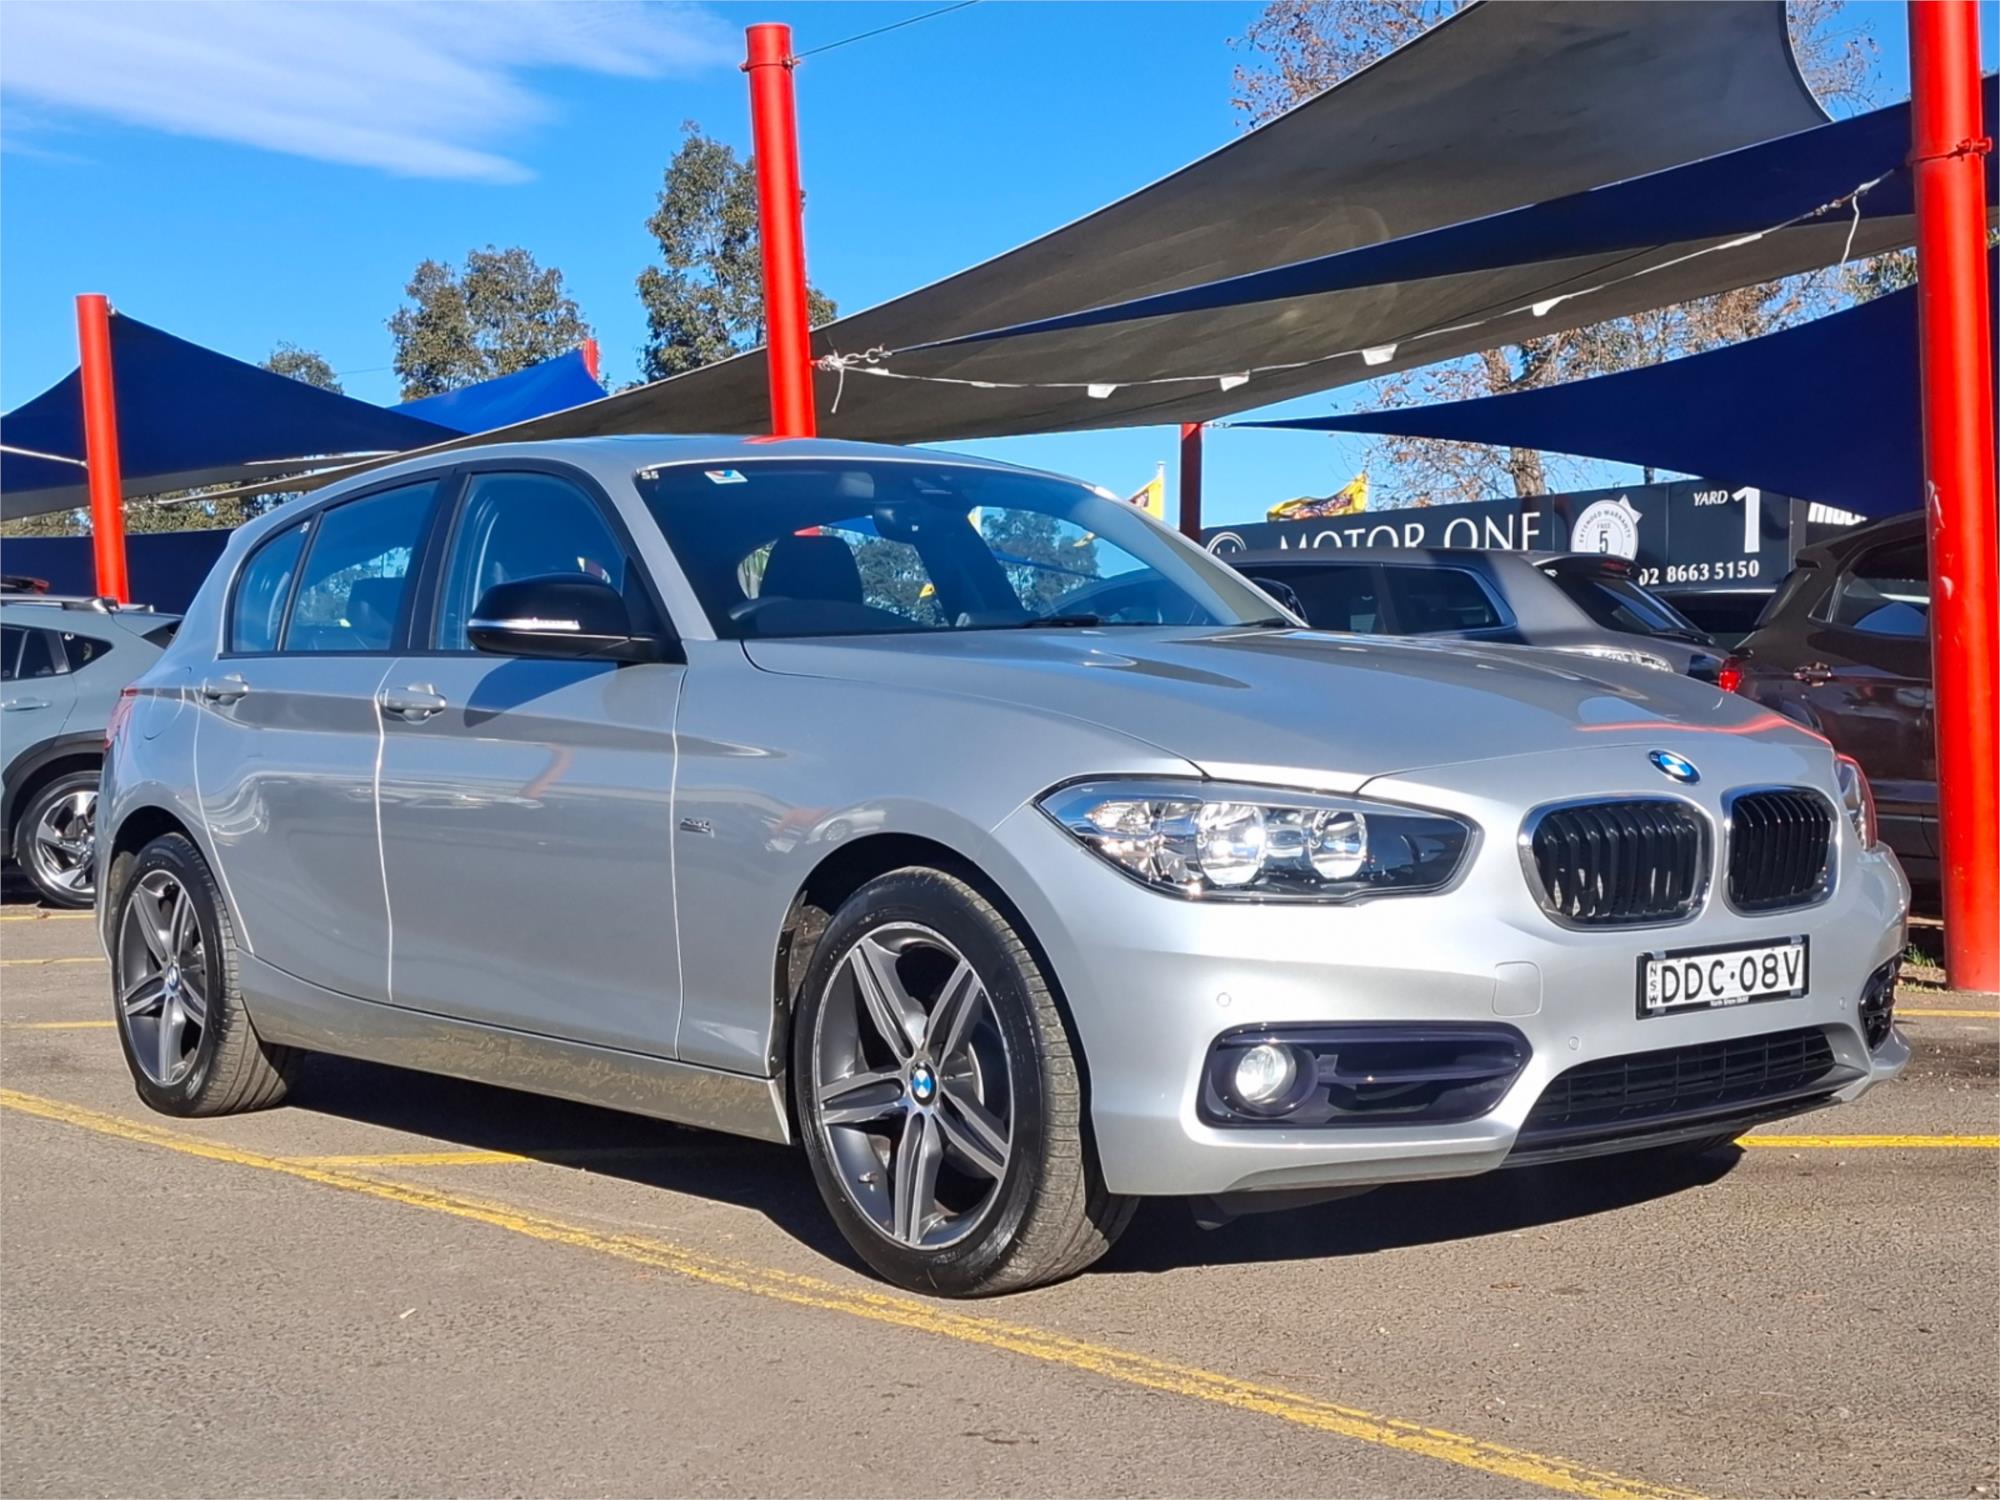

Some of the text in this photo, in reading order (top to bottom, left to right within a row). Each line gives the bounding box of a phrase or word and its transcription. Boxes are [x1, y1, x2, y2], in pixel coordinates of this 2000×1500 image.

[1443, 511, 1541, 551] ONE
[1693, 489, 1728, 506] YARD
[1731, 486, 1760, 553] 1
[1599, 530, 1609, 554] 5
[1638, 559, 1760, 586] 02 8663 5150
